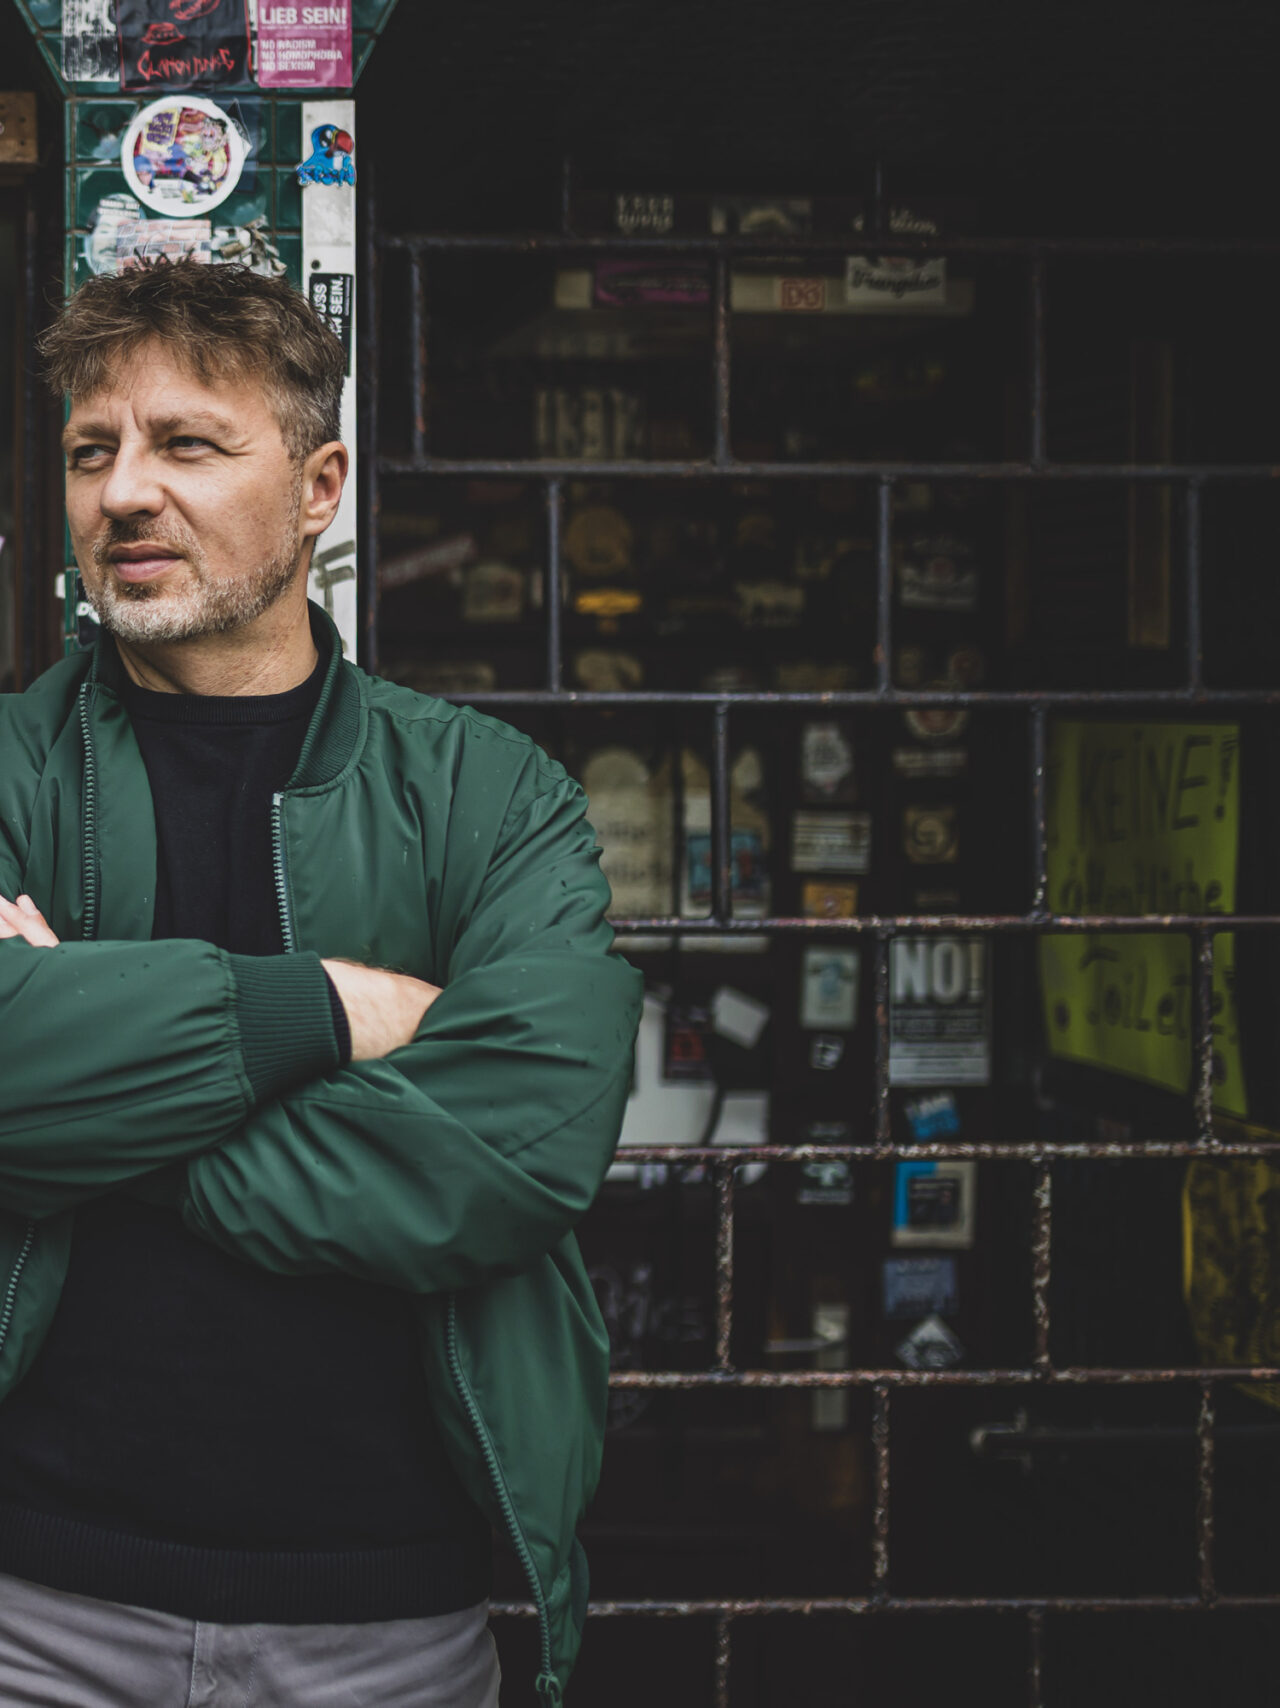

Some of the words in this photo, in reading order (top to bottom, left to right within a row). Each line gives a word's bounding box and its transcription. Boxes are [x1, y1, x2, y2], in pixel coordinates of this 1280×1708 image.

[260, 8, 297, 25] LIEB
[301, 8, 347, 25] SEIN!
[261, 39, 274, 49] NO
[261, 51, 274, 60] NO
[277, 51, 343, 60] HOMOPHOBIA
[261, 61, 274, 70] NO
[277, 61, 316, 70] SEXISM
[894, 941, 986, 1001] NO!
